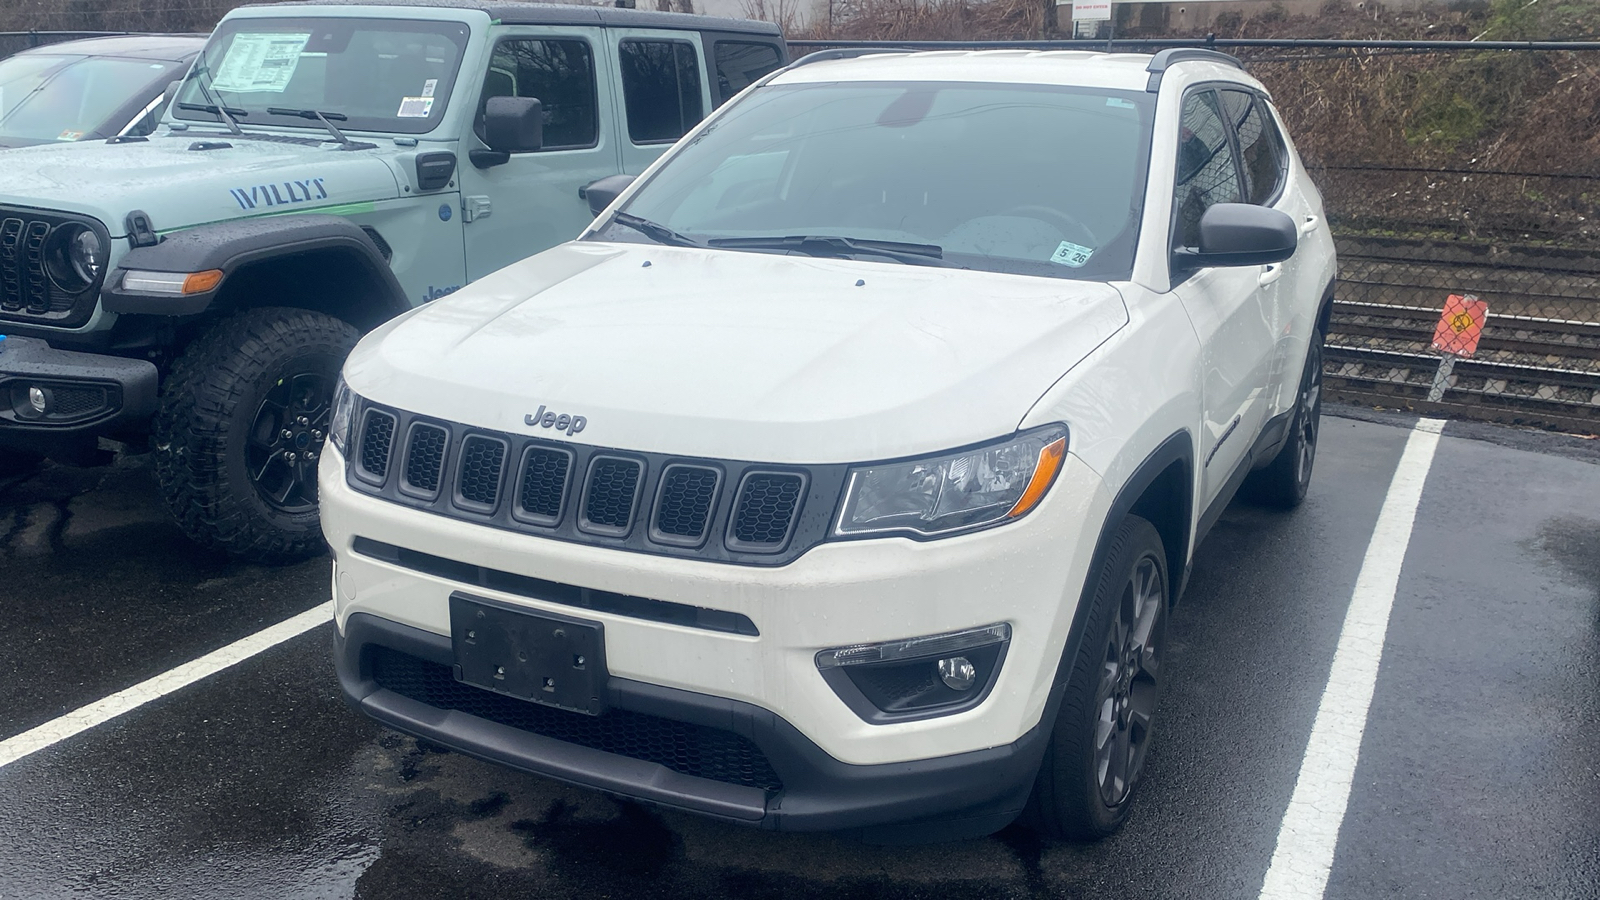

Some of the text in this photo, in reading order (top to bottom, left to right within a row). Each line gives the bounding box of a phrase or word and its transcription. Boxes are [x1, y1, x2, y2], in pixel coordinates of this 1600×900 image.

[230, 178, 327, 209] WILLYS
[1060, 248, 1069, 258] 5
[1072, 253, 1086, 263] 26
[524, 405, 587, 436] Jeep
